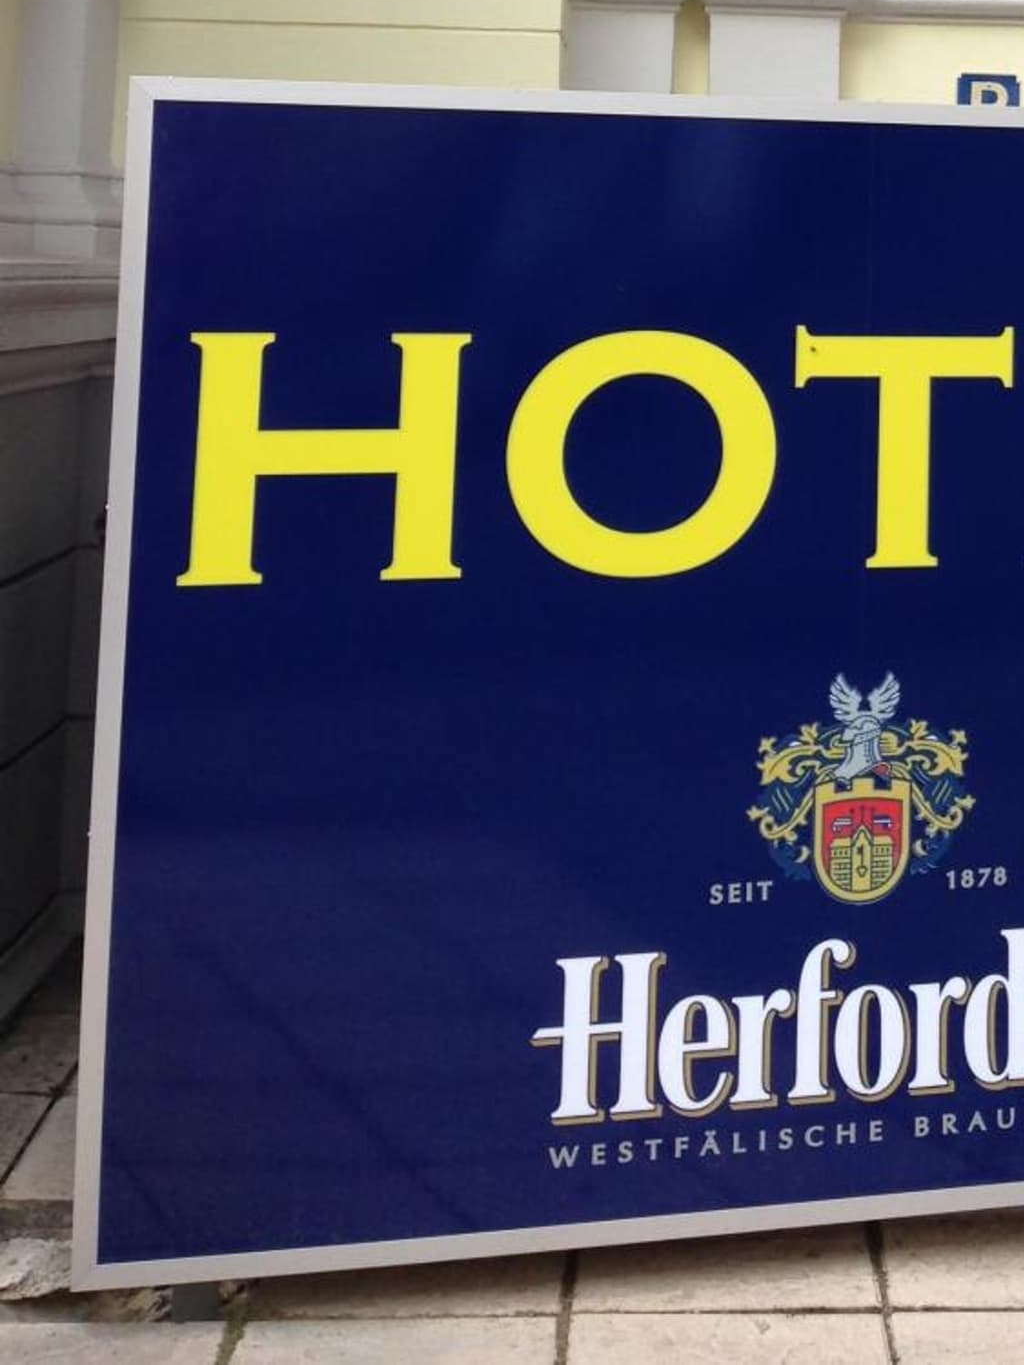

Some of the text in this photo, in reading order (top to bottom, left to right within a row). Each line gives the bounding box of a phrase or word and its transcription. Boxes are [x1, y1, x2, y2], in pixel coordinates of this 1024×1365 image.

[709, 866, 1008, 905] SEIT 1878
[549, 1119, 885, 1170] WESTFÄLISCHE
